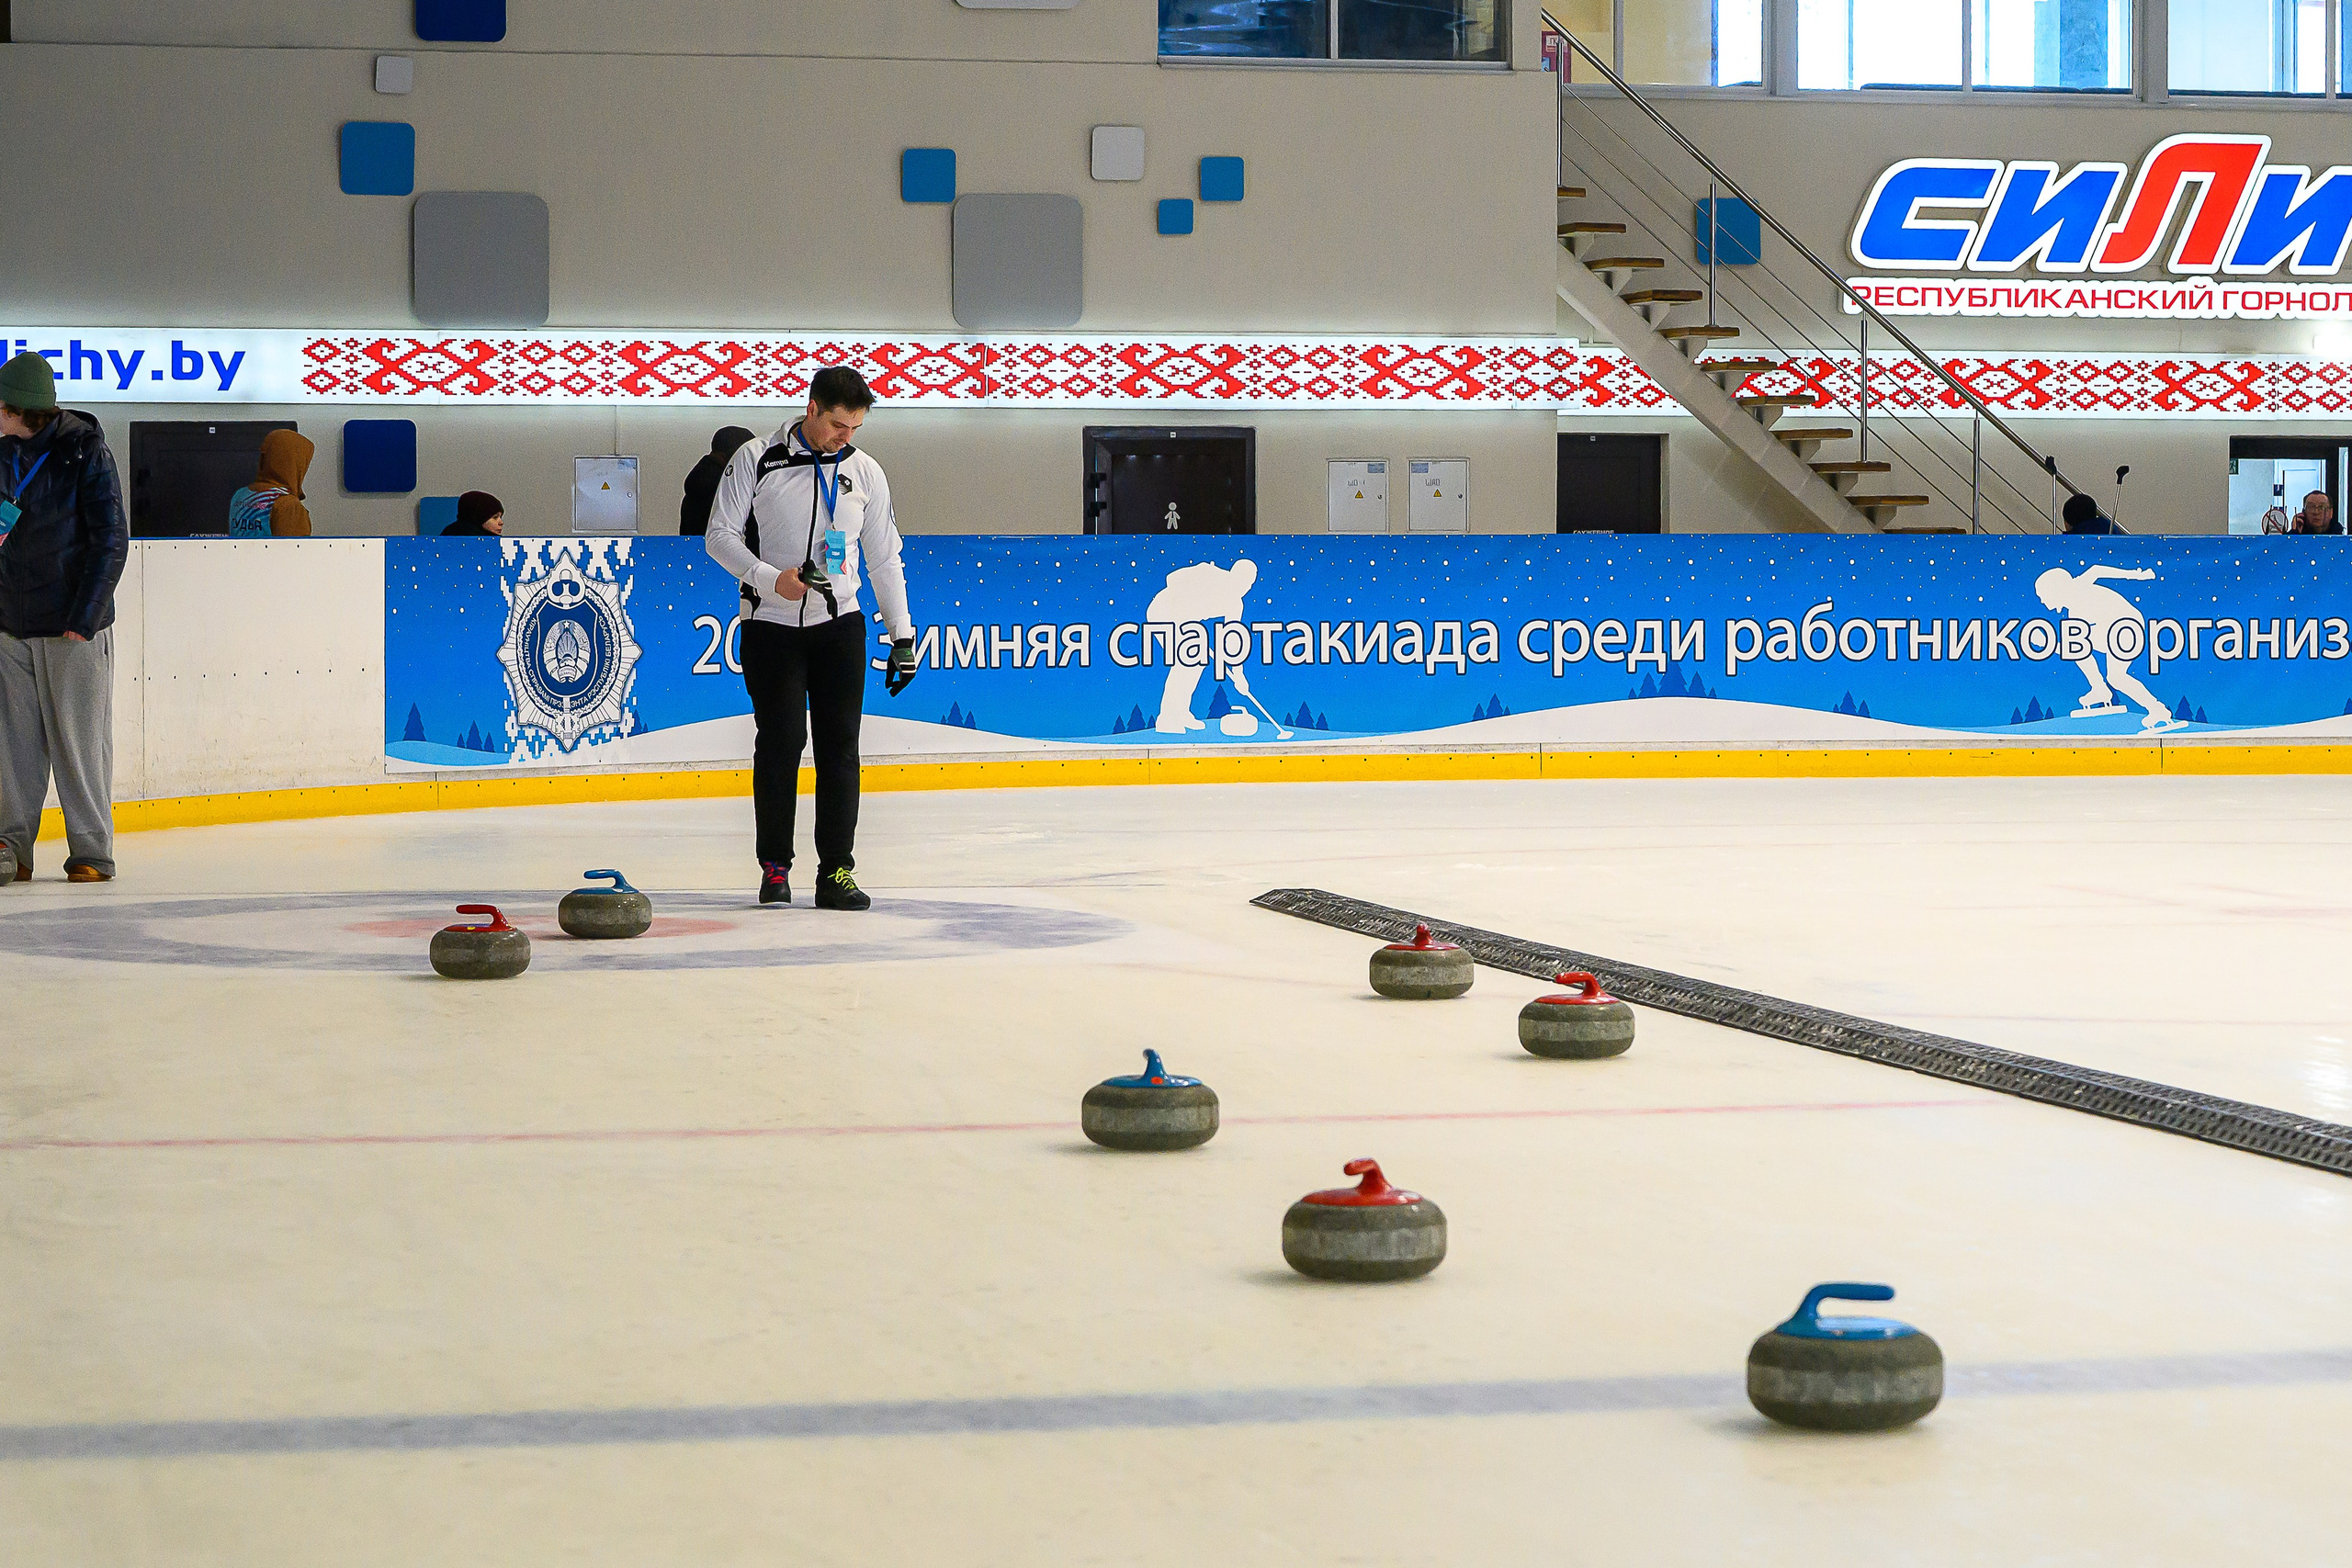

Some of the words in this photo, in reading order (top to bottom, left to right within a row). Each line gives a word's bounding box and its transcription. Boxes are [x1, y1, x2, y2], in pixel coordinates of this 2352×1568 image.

[1852, 285, 2212, 310] РЕСПУБЛИКАНСКИЙ
[2222, 290, 2352, 311] ГОРНОЛ
[597, 615, 613, 658] БЕЛАРУСЬ
[1108, 620, 1499, 680] спартакиада
[1518, 619, 1704, 677] среди
[1726, 601, 2092, 677] работников
